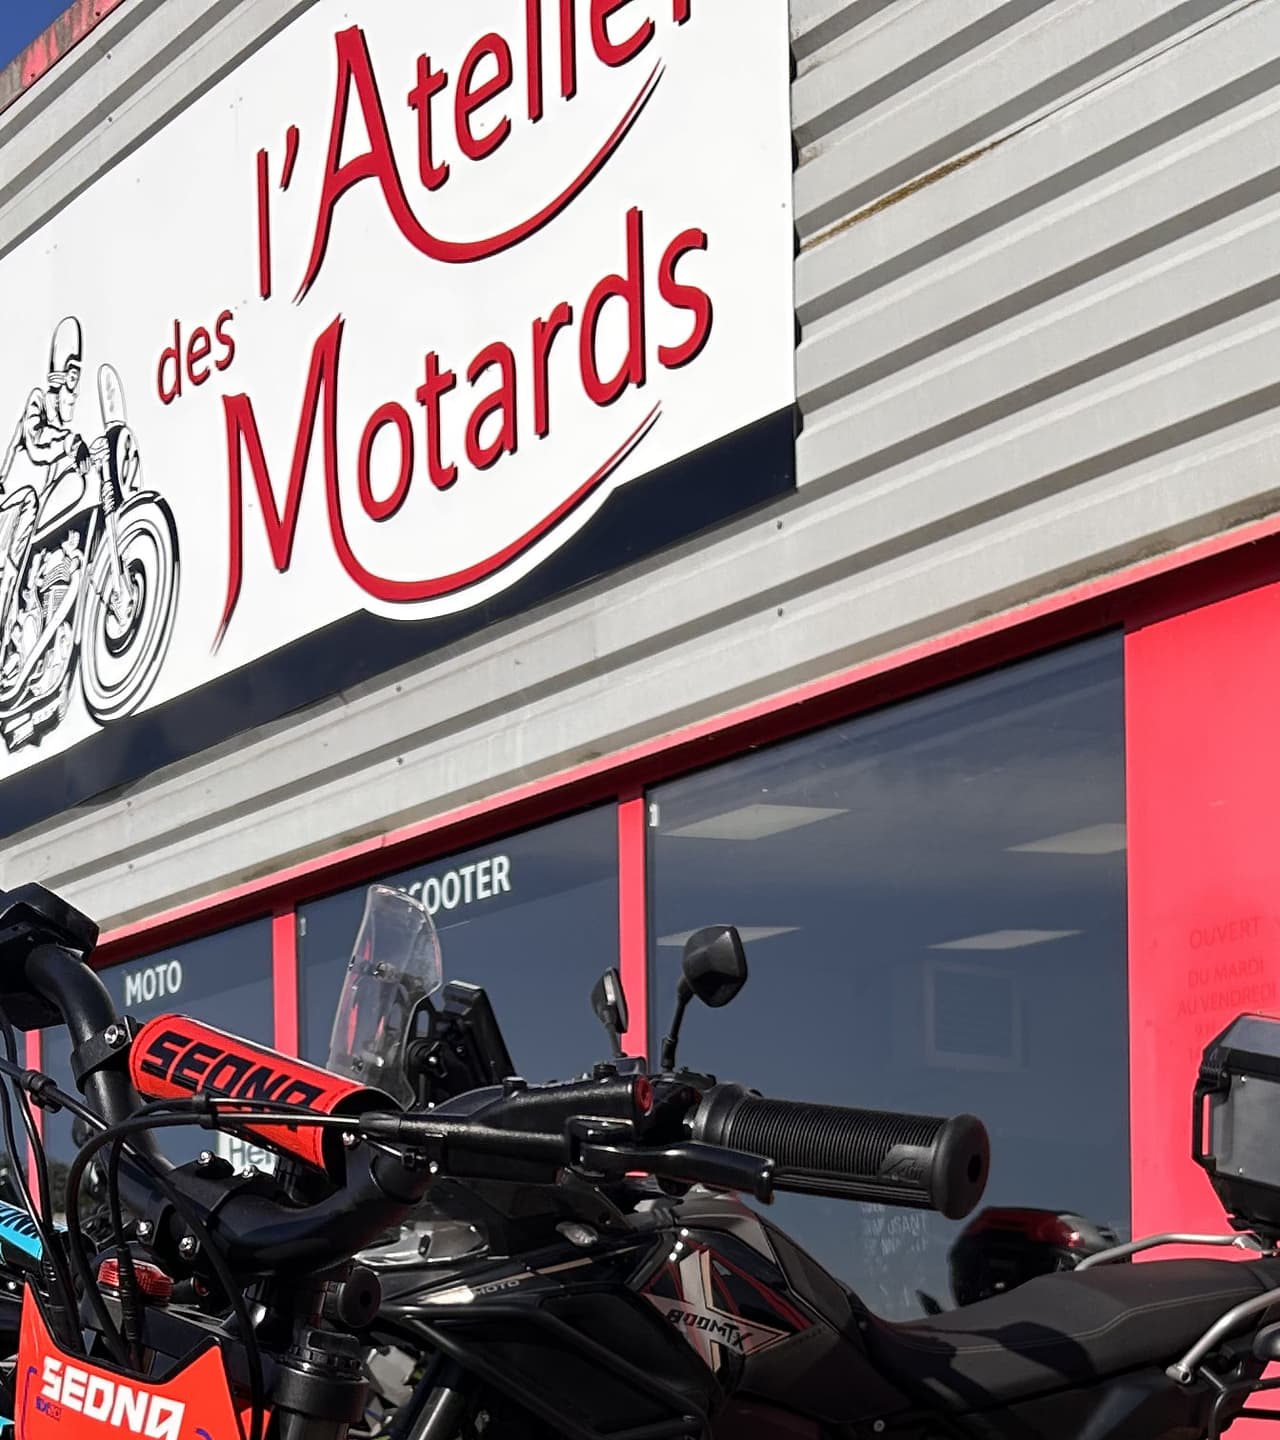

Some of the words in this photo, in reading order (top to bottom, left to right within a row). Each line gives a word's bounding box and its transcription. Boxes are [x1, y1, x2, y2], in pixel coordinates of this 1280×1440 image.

[256, 0, 691, 305] l'Atelie
[157, 308, 236, 405] des
[213, 206, 714, 655] Motards
[125, 960, 182, 1006] MOTO
